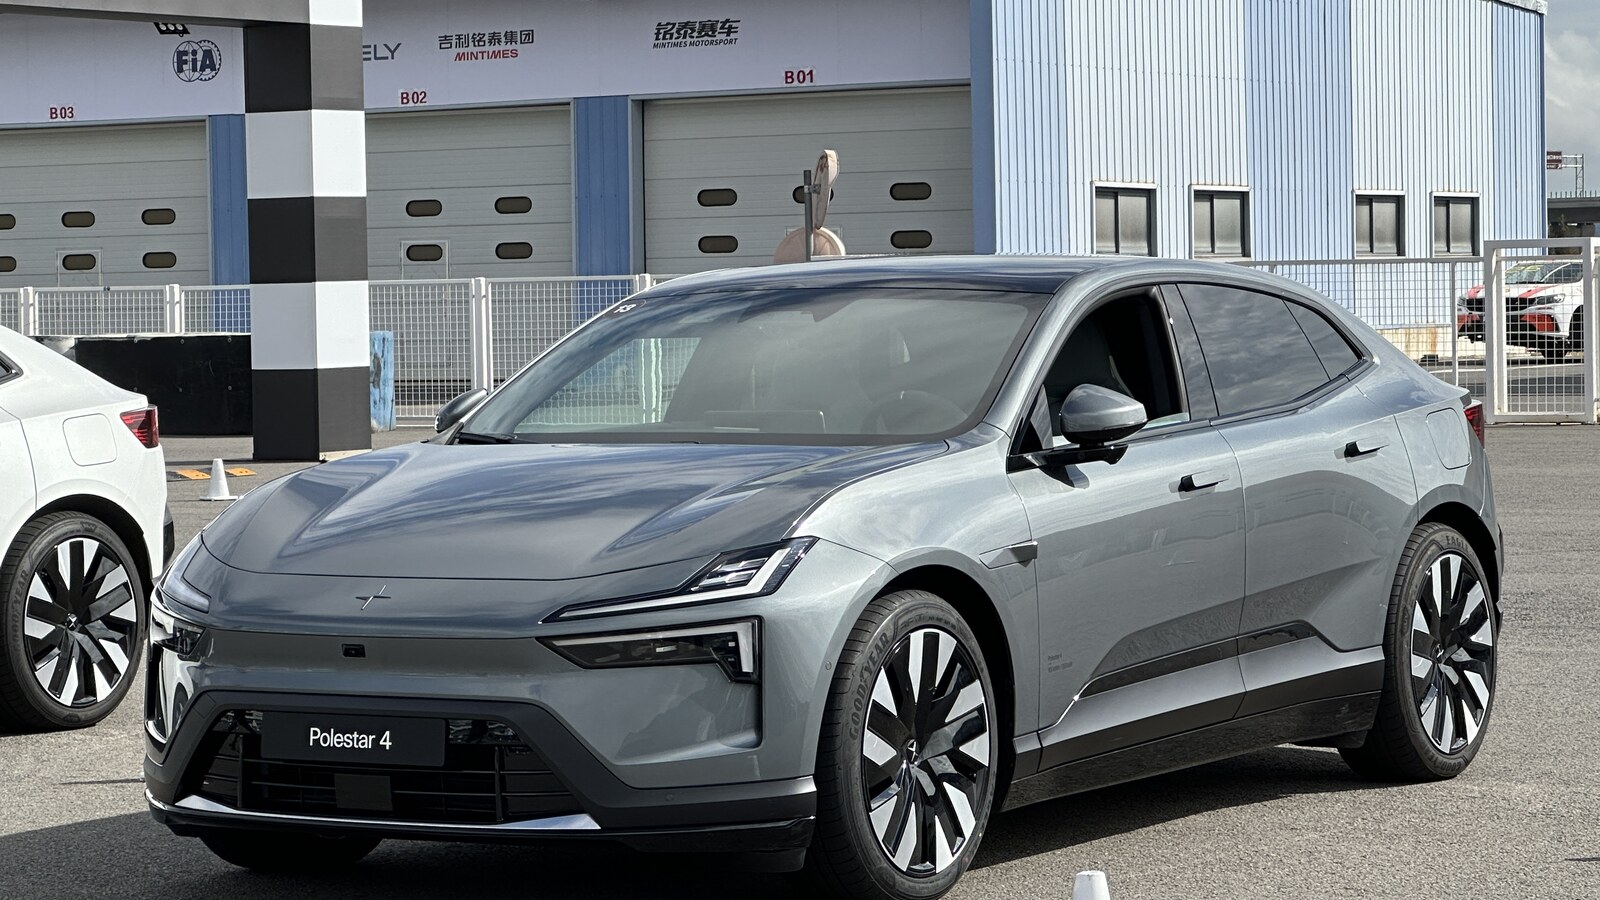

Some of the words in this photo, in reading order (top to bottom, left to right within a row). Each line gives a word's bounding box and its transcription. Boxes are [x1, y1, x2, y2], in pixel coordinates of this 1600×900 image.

[438, 29, 534, 50] 吉利铭泰集团
[654, 19, 741, 41] 铭泰赛车
[653, 40, 687, 49] MINTIMES
[689, 38, 738, 47] MOTORSPORT
[454, 49, 519, 62] MINTIMES
[849, 632, 890, 741] GOODYEAR
[309, 727, 376, 749] Polestar
[379, 730, 392, 750] 4
